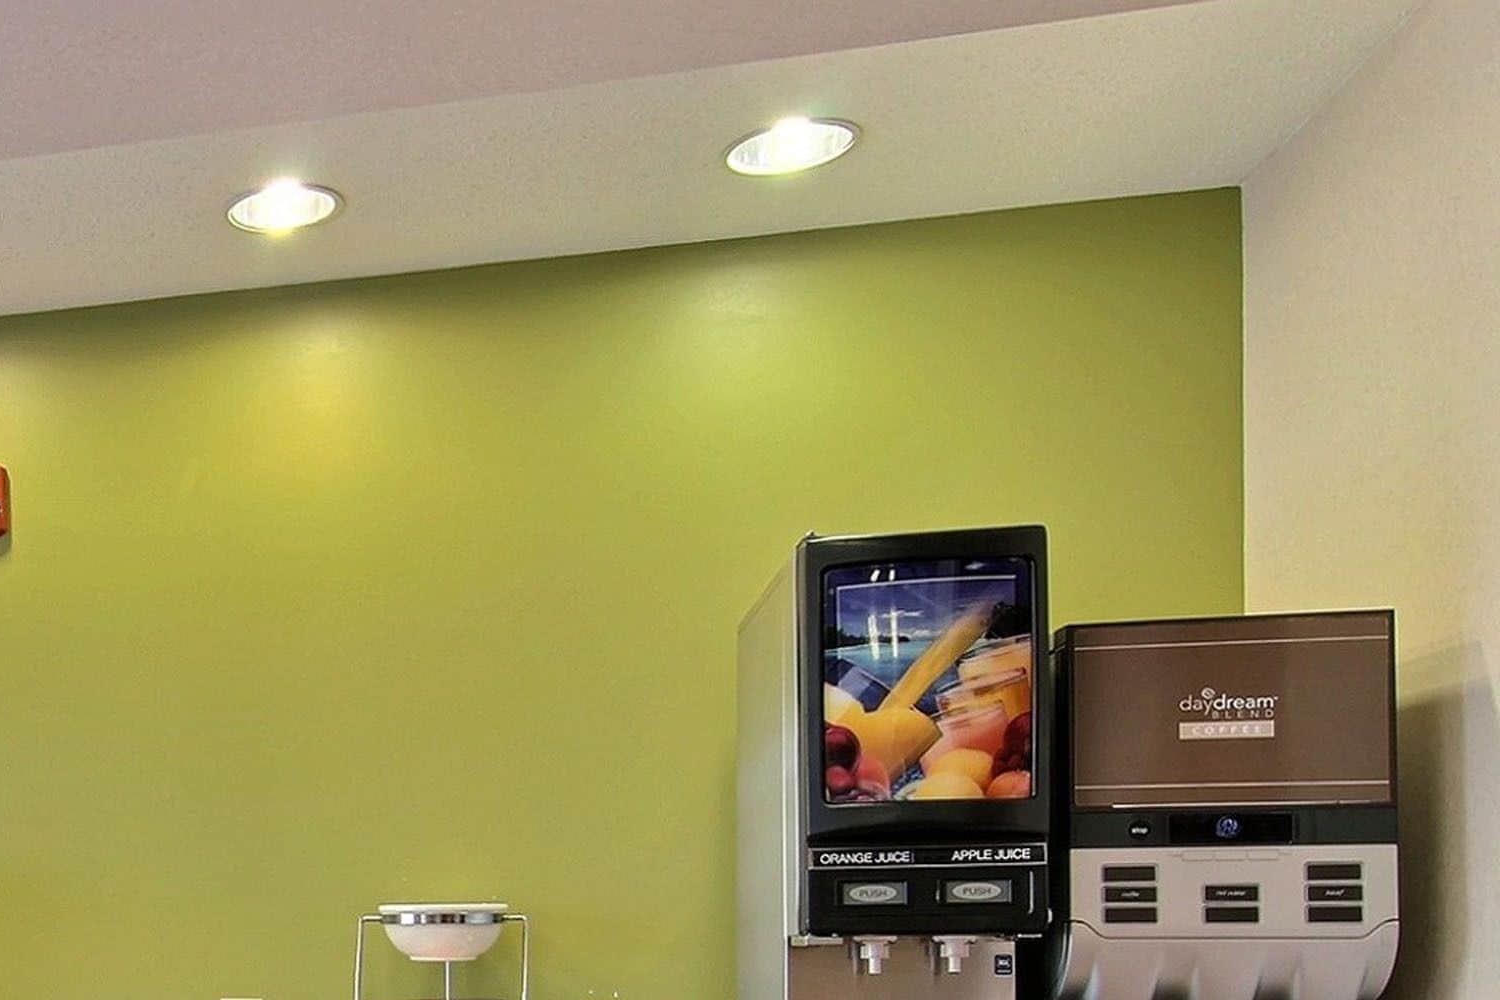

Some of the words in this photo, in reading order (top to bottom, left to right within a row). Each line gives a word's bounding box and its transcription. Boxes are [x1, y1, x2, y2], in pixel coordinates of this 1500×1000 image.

[1179, 693, 1275, 716] daydream
[1211, 709, 1274, 719] BLEND
[819, 851, 873, 865] ORANGE
[874, 850, 910, 864] JUICE
[951, 848, 993, 861] APPLE
[993, 846, 1031, 860] JUICE
[858, 888, 888, 898] PUSH
[963, 886, 992, 896] PUSH
